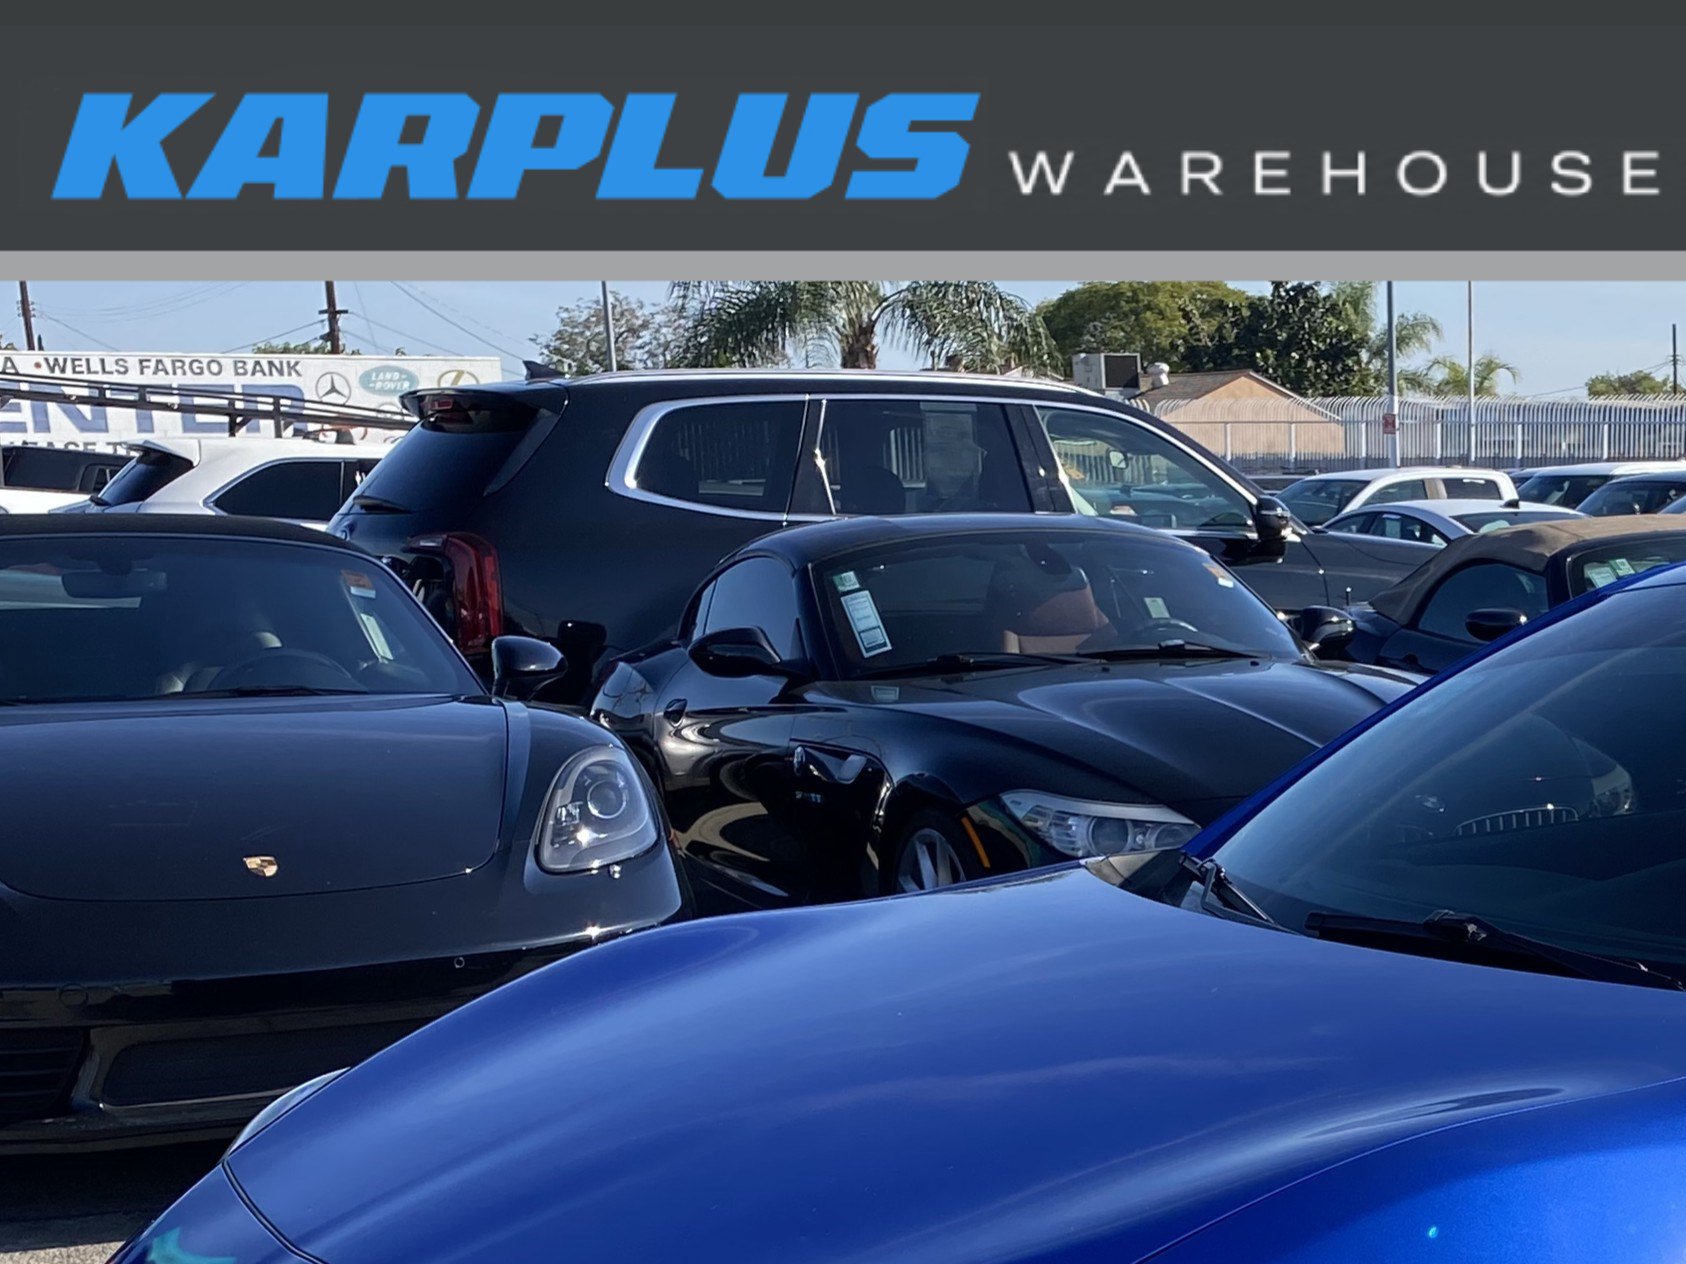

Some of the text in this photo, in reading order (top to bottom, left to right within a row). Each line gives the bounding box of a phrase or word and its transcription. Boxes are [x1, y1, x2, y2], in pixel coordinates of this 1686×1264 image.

[44, 357, 129, 375] WELLS
[140, 358, 223, 376] FARGO
[233, 360, 302, 377] BANK
